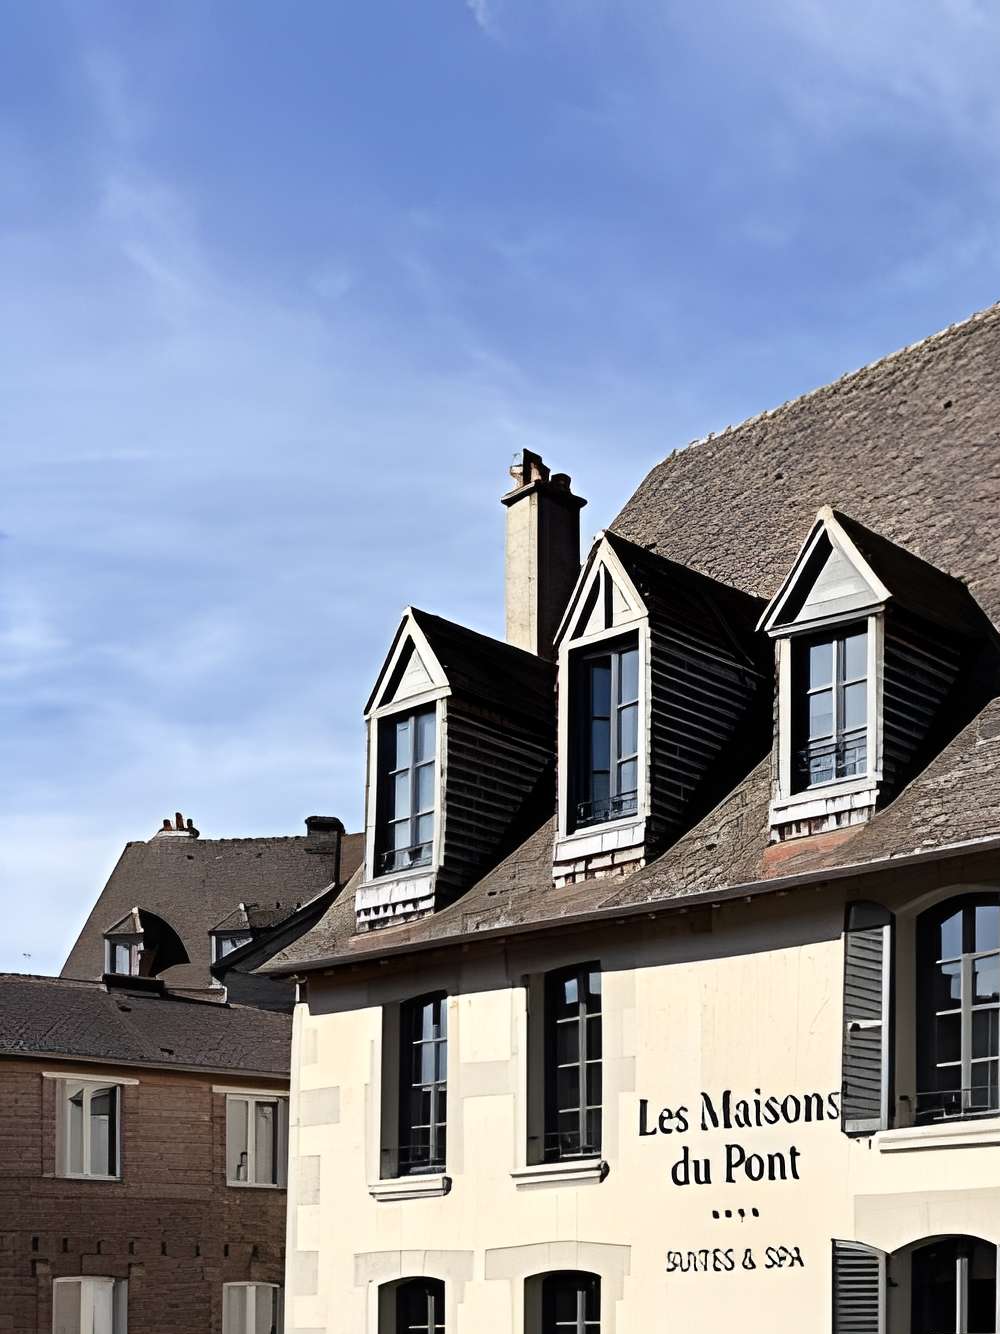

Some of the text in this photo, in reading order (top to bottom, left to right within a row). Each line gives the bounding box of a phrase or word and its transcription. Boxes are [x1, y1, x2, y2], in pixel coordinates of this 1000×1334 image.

[638, 1087, 840, 1137] Les Maisons
[671, 1143, 801, 1187] du Pont
